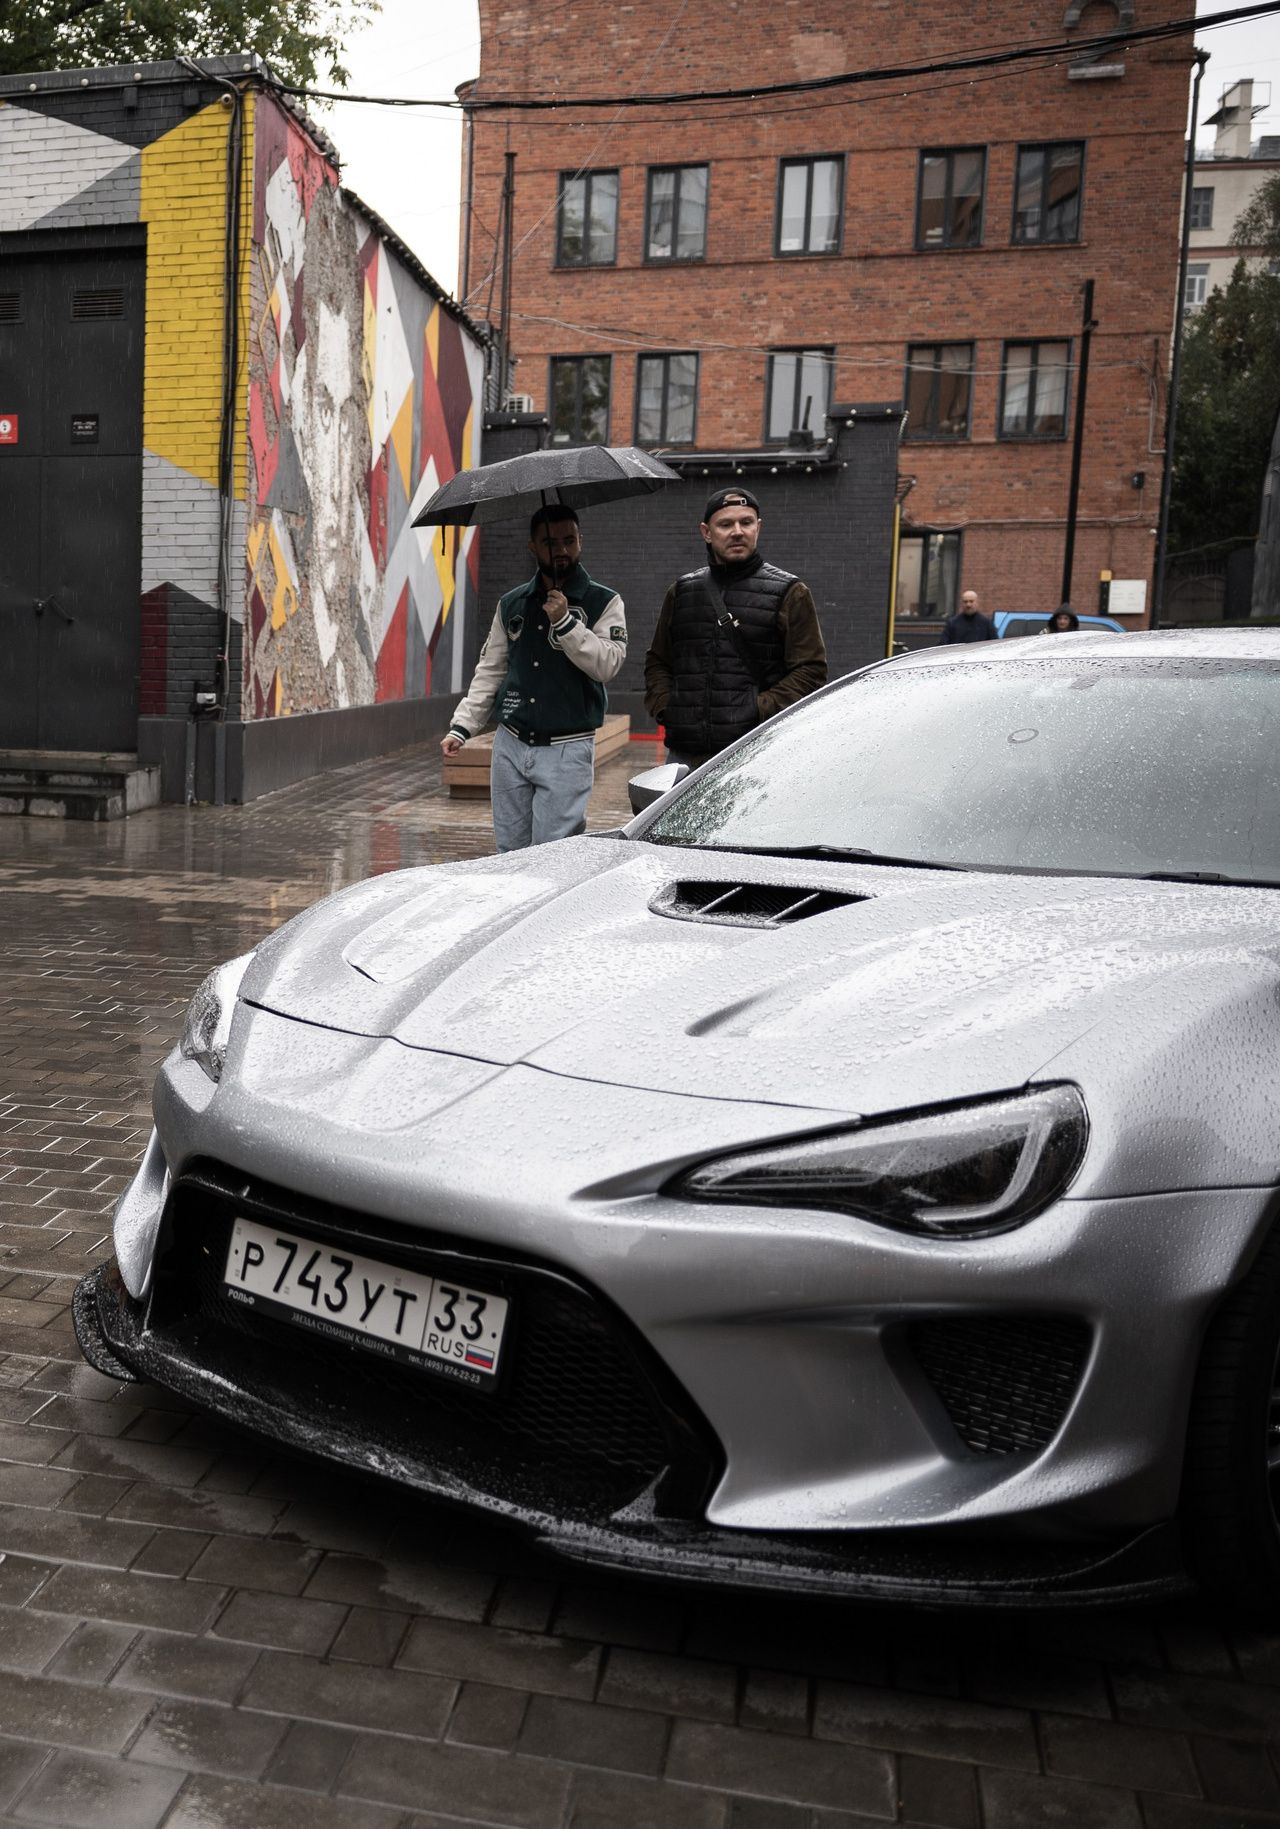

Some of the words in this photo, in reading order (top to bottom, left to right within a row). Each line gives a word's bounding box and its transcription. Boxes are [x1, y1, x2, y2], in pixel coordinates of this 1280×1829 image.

[227, 1288, 255, 1305] РОЛЬФ
[434, 1285, 489, 1341] 33
[291, 1311, 317, 1330] ЗВЕЗДА
[316, 1321, 355, 1341] СТОЛИЦЫ
[354, 1333, 396, 1356] КАШИРКА
[427, 1332, 465, 1358] RUS
[424, 1357, 443, 1372] (495)
[444, 1364, 481, 1384] 974-22-23
